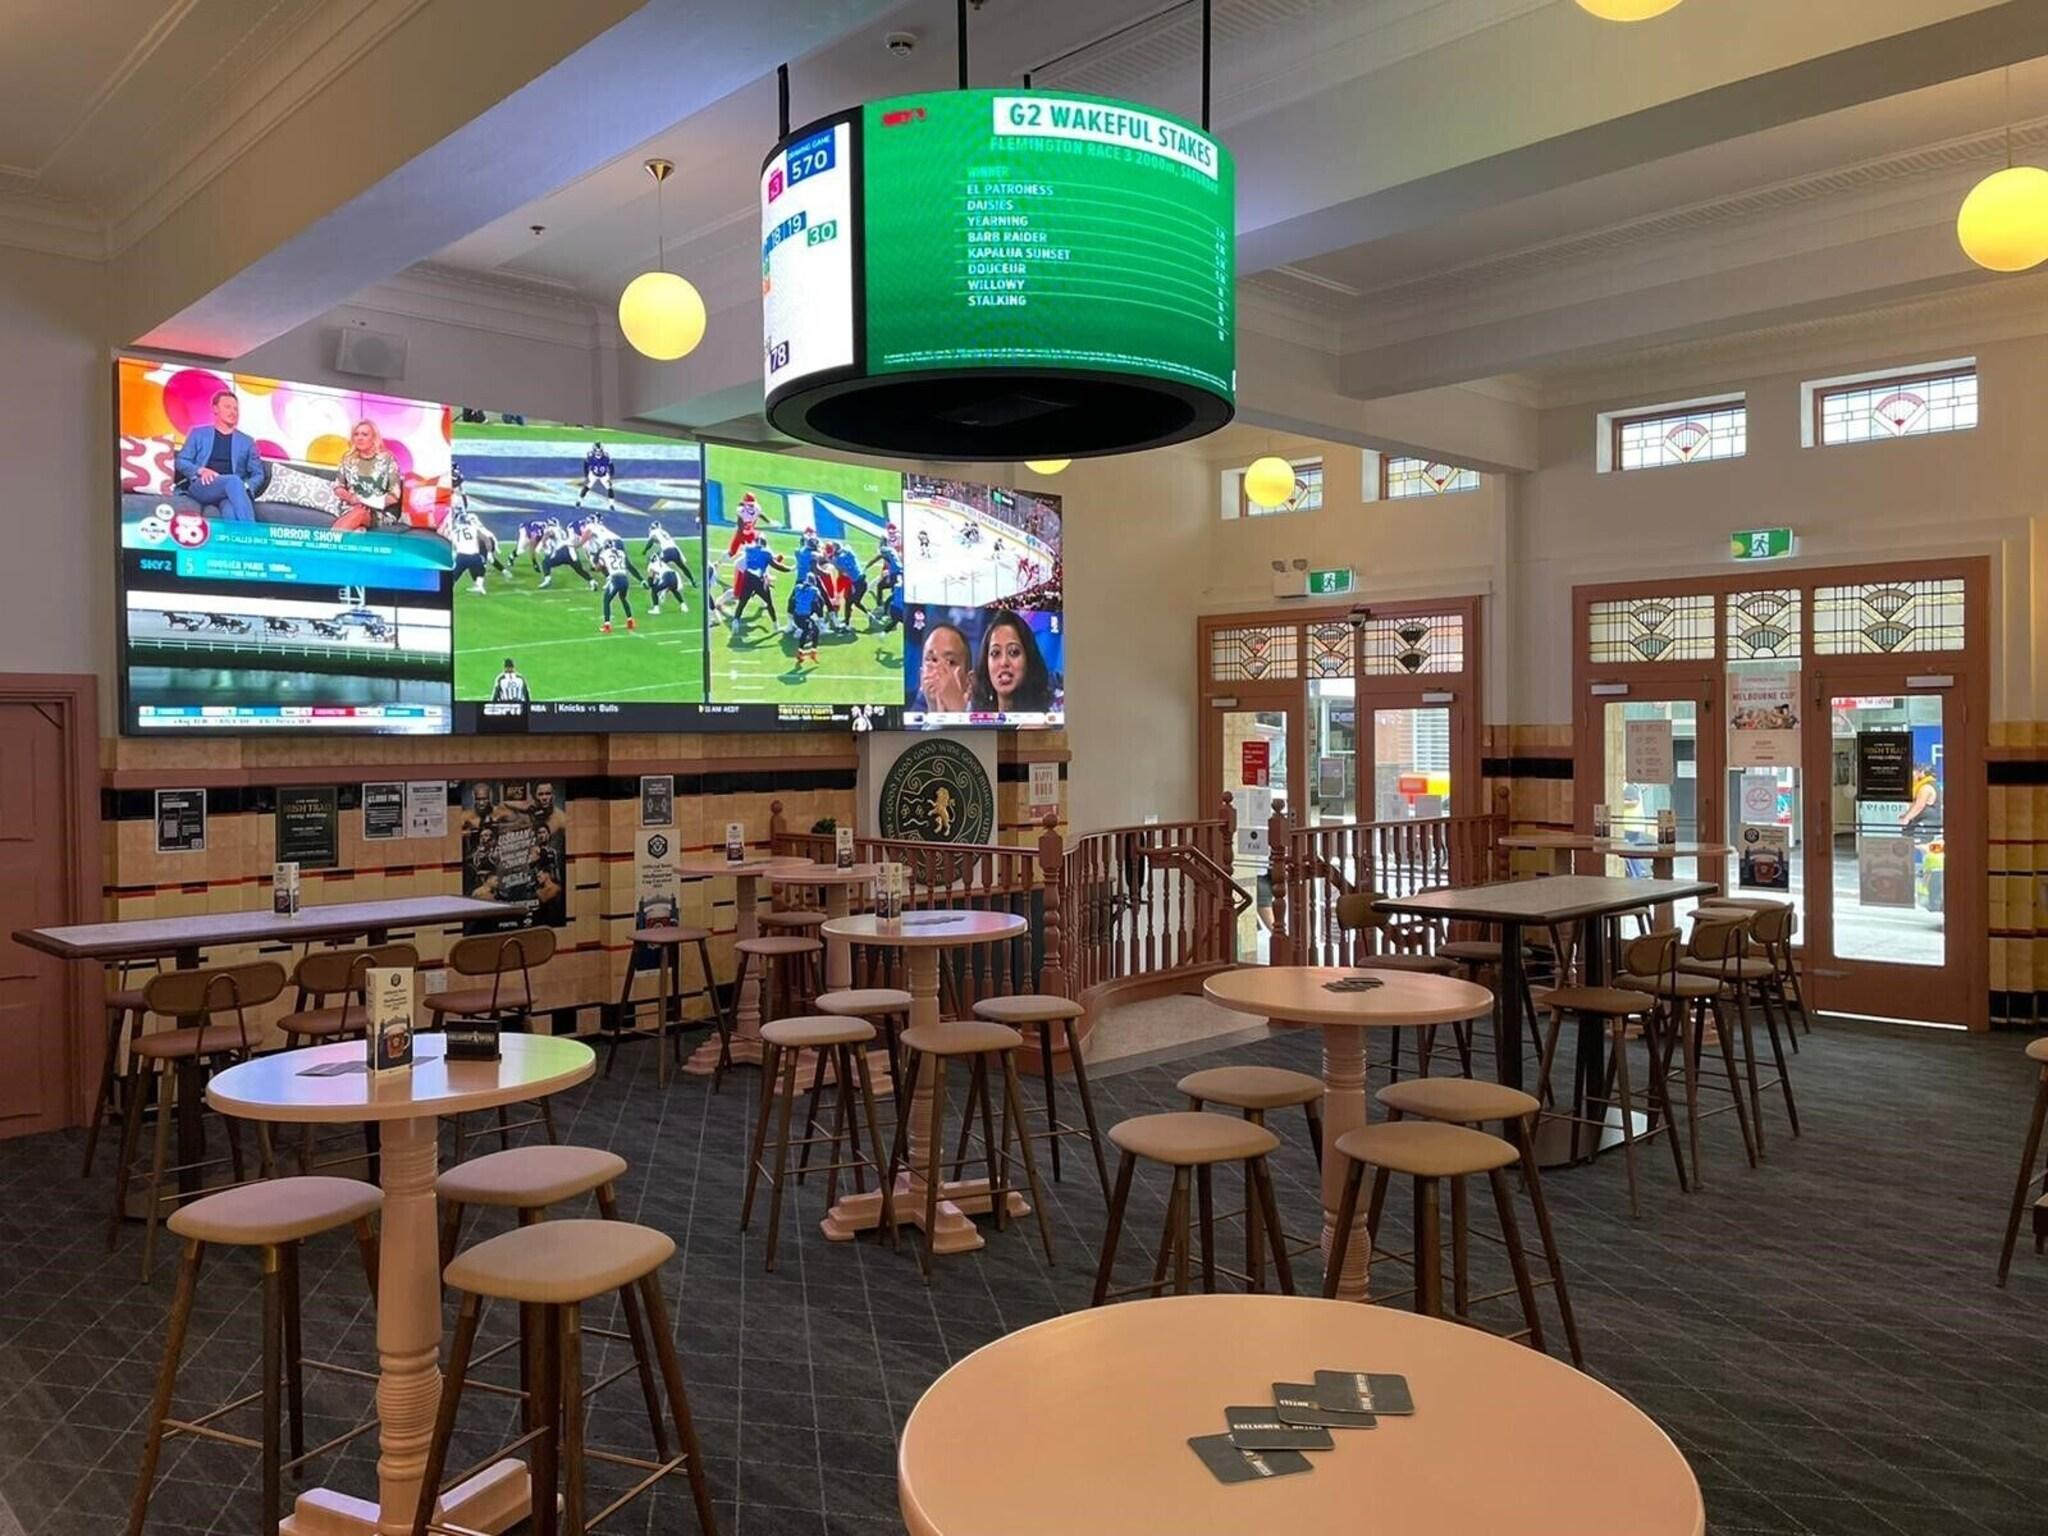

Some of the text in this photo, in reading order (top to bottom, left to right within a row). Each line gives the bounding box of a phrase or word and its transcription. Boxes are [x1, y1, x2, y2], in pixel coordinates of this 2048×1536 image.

[1009, 103, 1212, 168] G2 WAKEFUL STAKES
[989, 136, 1083, 155] FLEMINGTON
[1087, 143, 1121, 161] RACE
[1123, 148, 1132, 162] 3
[792, 150, 828, 180] 570
[967, 183, 1054, 196] EL PATRONESS
[967, 199, 1014, 211] DAISIES
[786, 215, 802, 234] 19
[967, 215, 1029, 227] YEARNING
[809, 222, 834, 245] 30
[967, 231, 1048, 243] BARB RAIDER
[968, 247, 1071, 260] KAPALUA SUNSET
[968, 263, 1027, 275] DOUCEUR
[967, 279, 1025, 291] WILLOWY
[967, 295, 1027, 307] STALKING
[269, 527, 310, 541] HORROR
[313, 530, 343, 543] SHOW
[608, 554, 626, 571] 22
[1732, 692, 1777, 701] MELBOURNE
[483, 703, 521, 716] ESPN
[558, 703, 585, 713] Knicks
